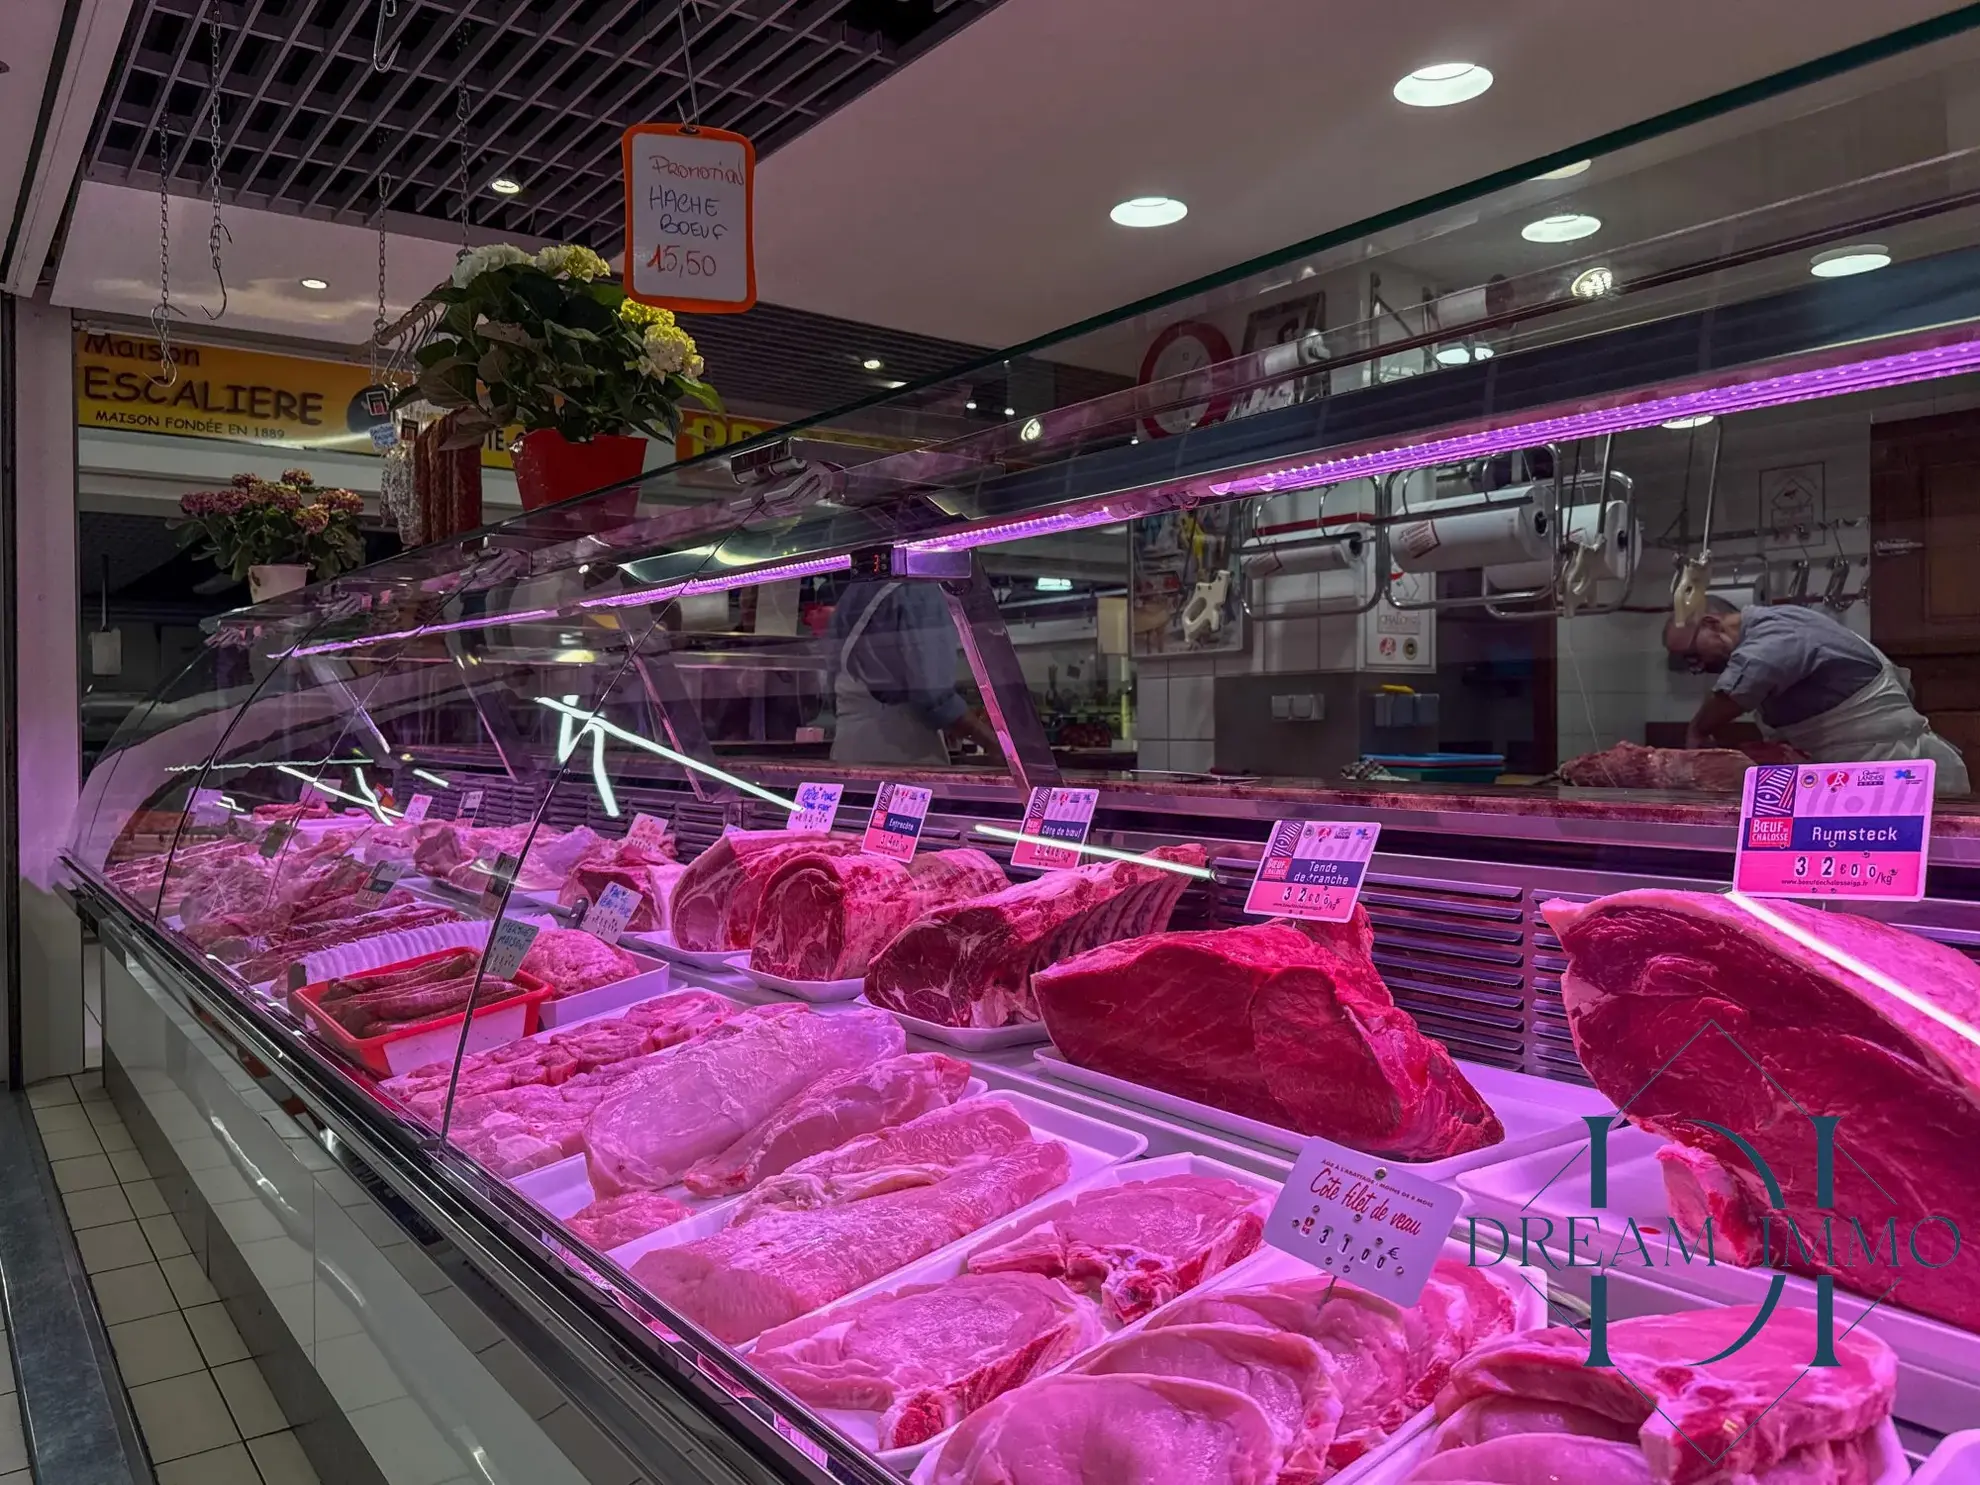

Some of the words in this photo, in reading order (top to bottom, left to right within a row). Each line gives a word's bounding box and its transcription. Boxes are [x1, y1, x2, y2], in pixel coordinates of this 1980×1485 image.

[649, 184, 719, 217] HACHE
[660, 213, 728, 240] BOEUF
[646, 244, 717, 278] 15,50
[84, 334, 200, 367] Maison
[83, 366, 325, 426] ESCALIERE
[95, 411, 160, 427] MAISON
[165, 417, 223, 434] FONDÉE
[228, 424, 248, 437] EN
[253, 427, 285, 440] 1889
[1752, 833, 1789, 842] CHALOSSE
[1812, 827, 1898, 841] Rumsteck
[1294, 872, 1305, 882] de
[1309, 861, 1338, 873] Tende
[1341, 1182, 1377, 1213] filet
[1370, 1198, 1390, 1221] de
[1390, 1212, 1423, 1236] veau
[1379, 1182, 1401, 1195] MOINS
[1401, 1191, 1410, 1199] DE
[1416, 1197, 1434, 1208] MOIS
